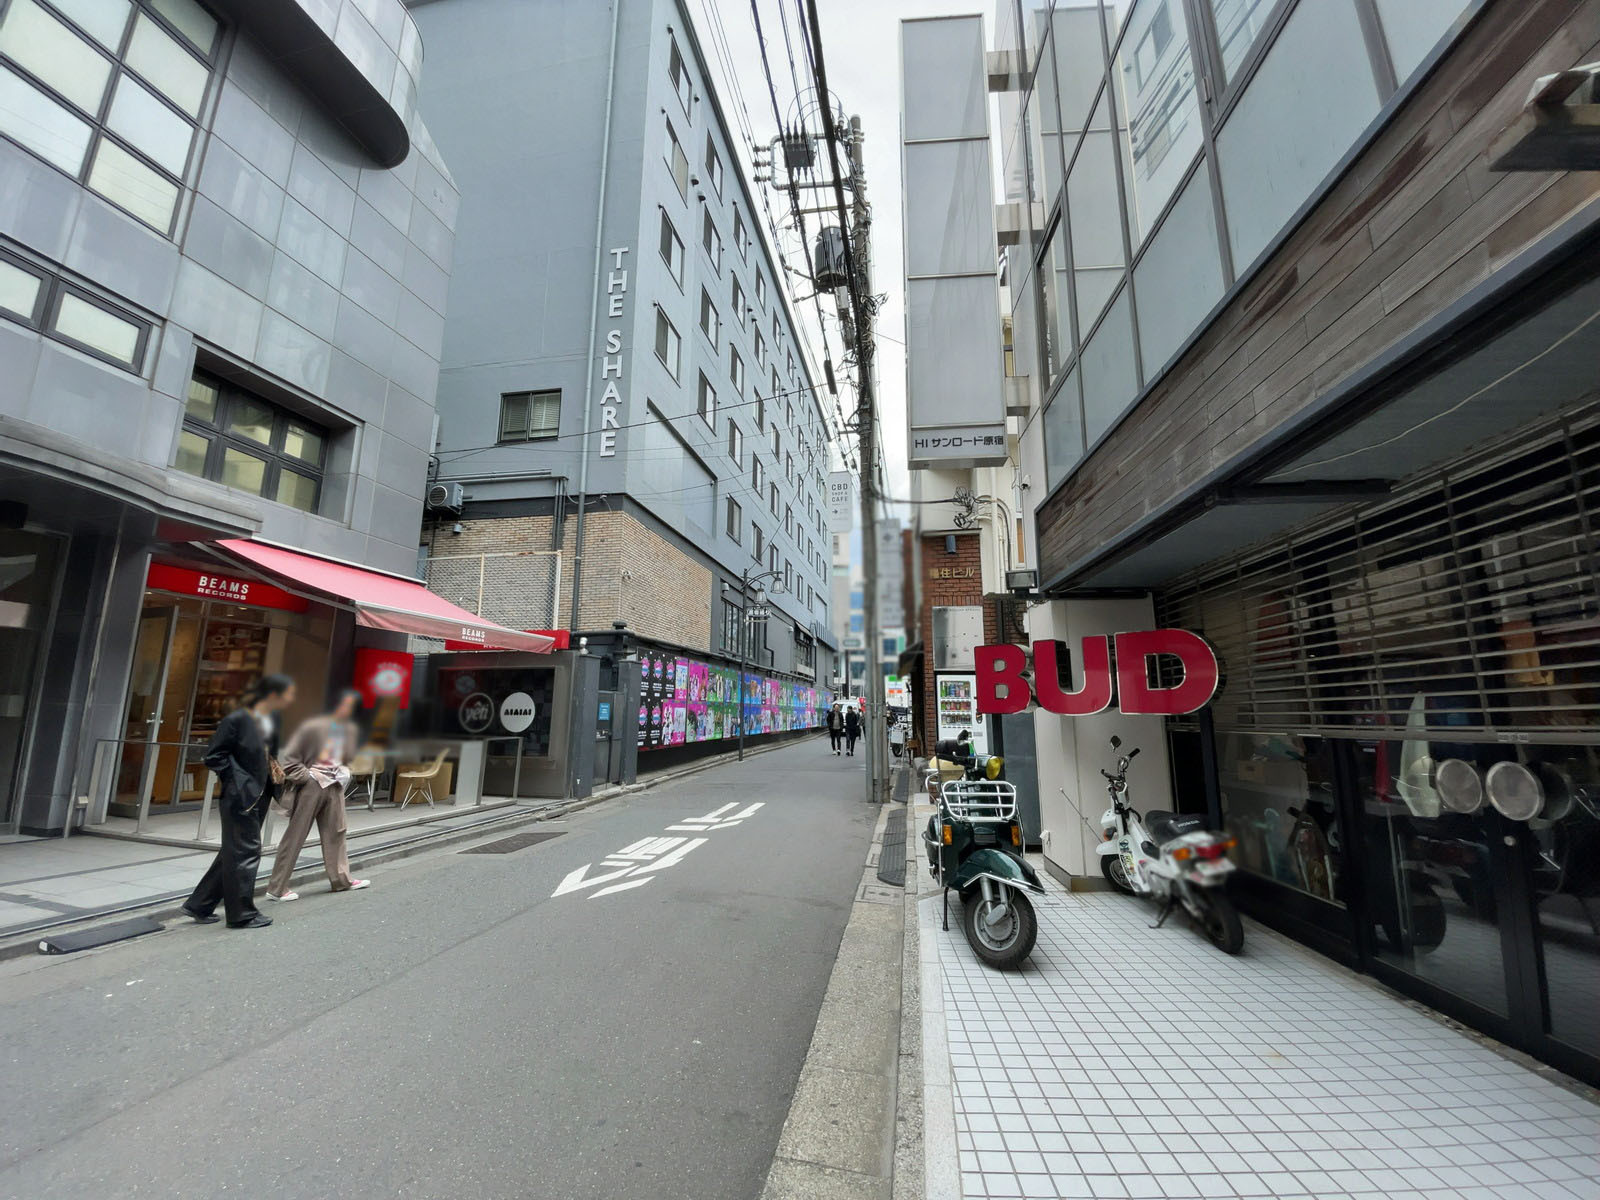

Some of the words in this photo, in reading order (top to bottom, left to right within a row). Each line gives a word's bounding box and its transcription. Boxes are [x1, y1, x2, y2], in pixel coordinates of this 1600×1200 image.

[607, 246, 629, 317] THE
[599, 329, 623, 457] SHARE
[915, 439, 928, 448] HI
[931, 435, 1004, 447] サンロード原宿
[199, 575, 249, 594] BEAMS
[197, 587, 247, 601] RECORDS
[461, 627, 486, 638] BEAMS
[461, 635, 485, 643] RECORDS
[974, 628, 1219, 716] BUD
[503, 708, 532, 716] AIAIAI
